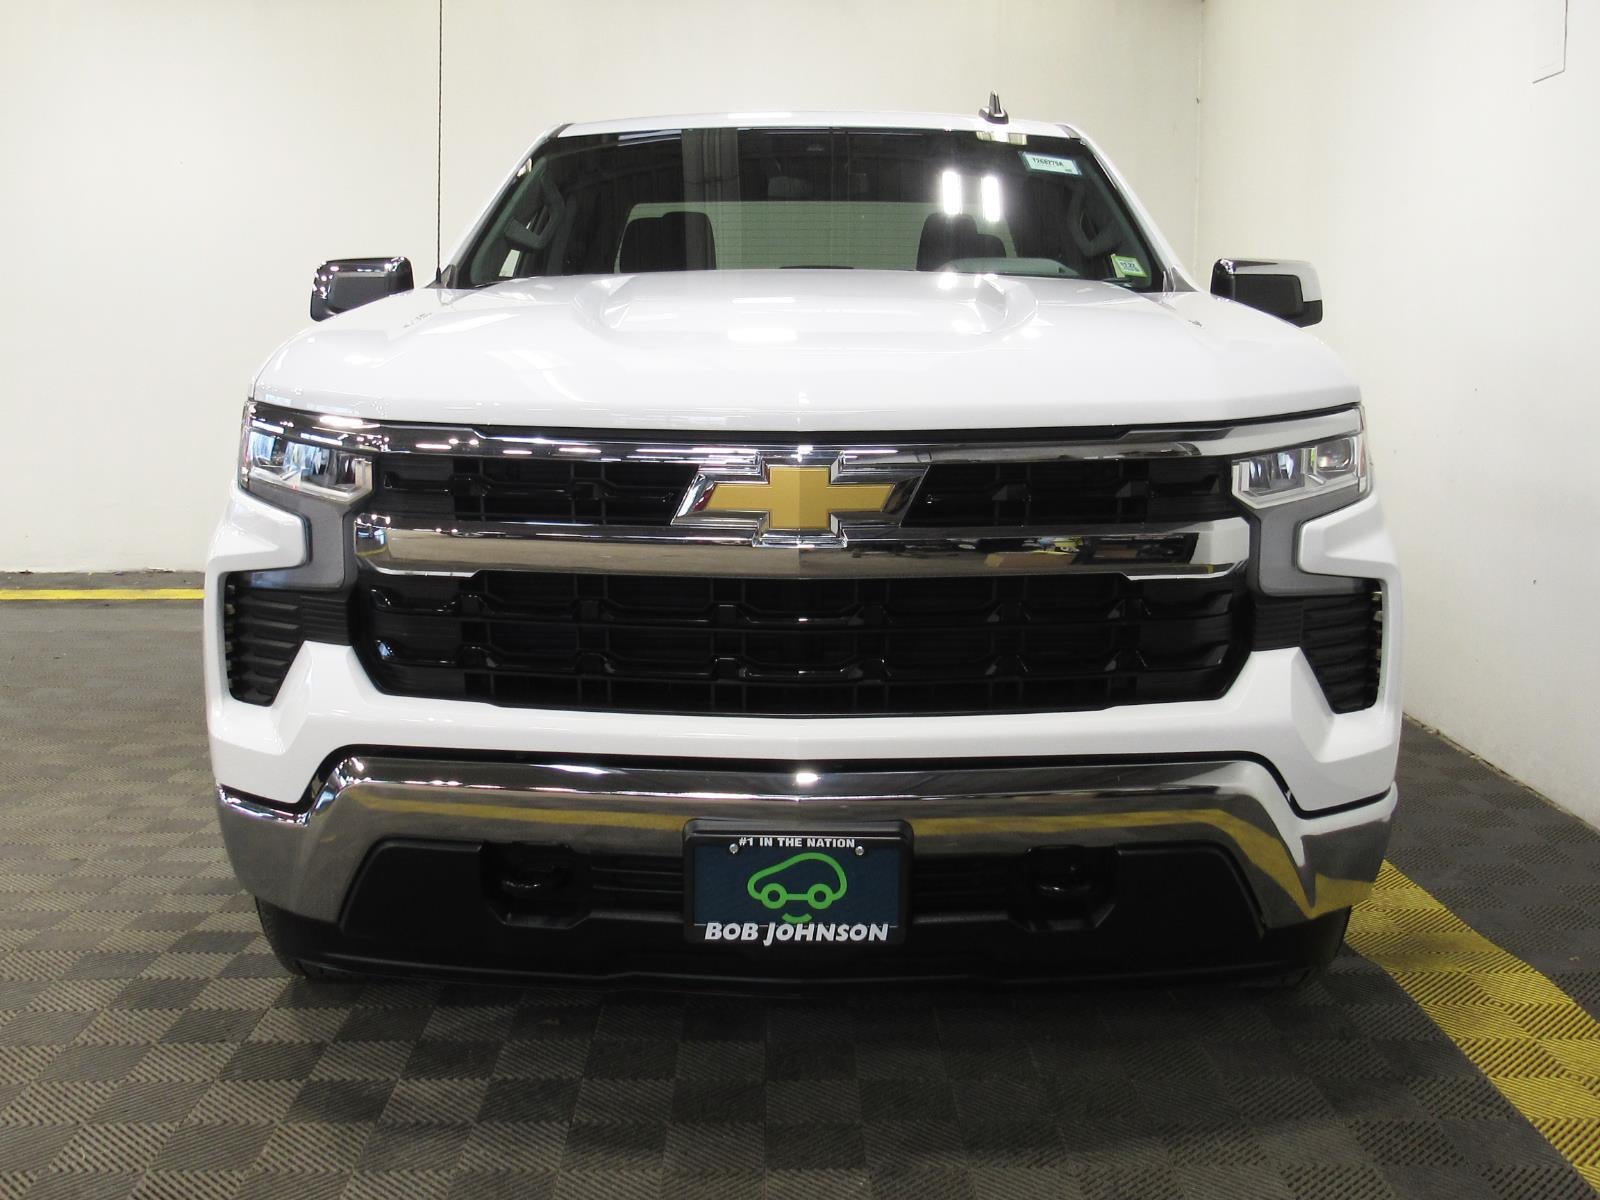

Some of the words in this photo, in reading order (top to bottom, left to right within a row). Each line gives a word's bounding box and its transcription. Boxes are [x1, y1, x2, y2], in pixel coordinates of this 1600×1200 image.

[738, 837, 754, 847] #1
[759, 837, 773, 847] IN
[777, 837, 802, 847] THE
[806, 837, 855, 848] NATION
[704, 922, 759, 941] BOB
[763, 922, 889, 947] JOHNSON
